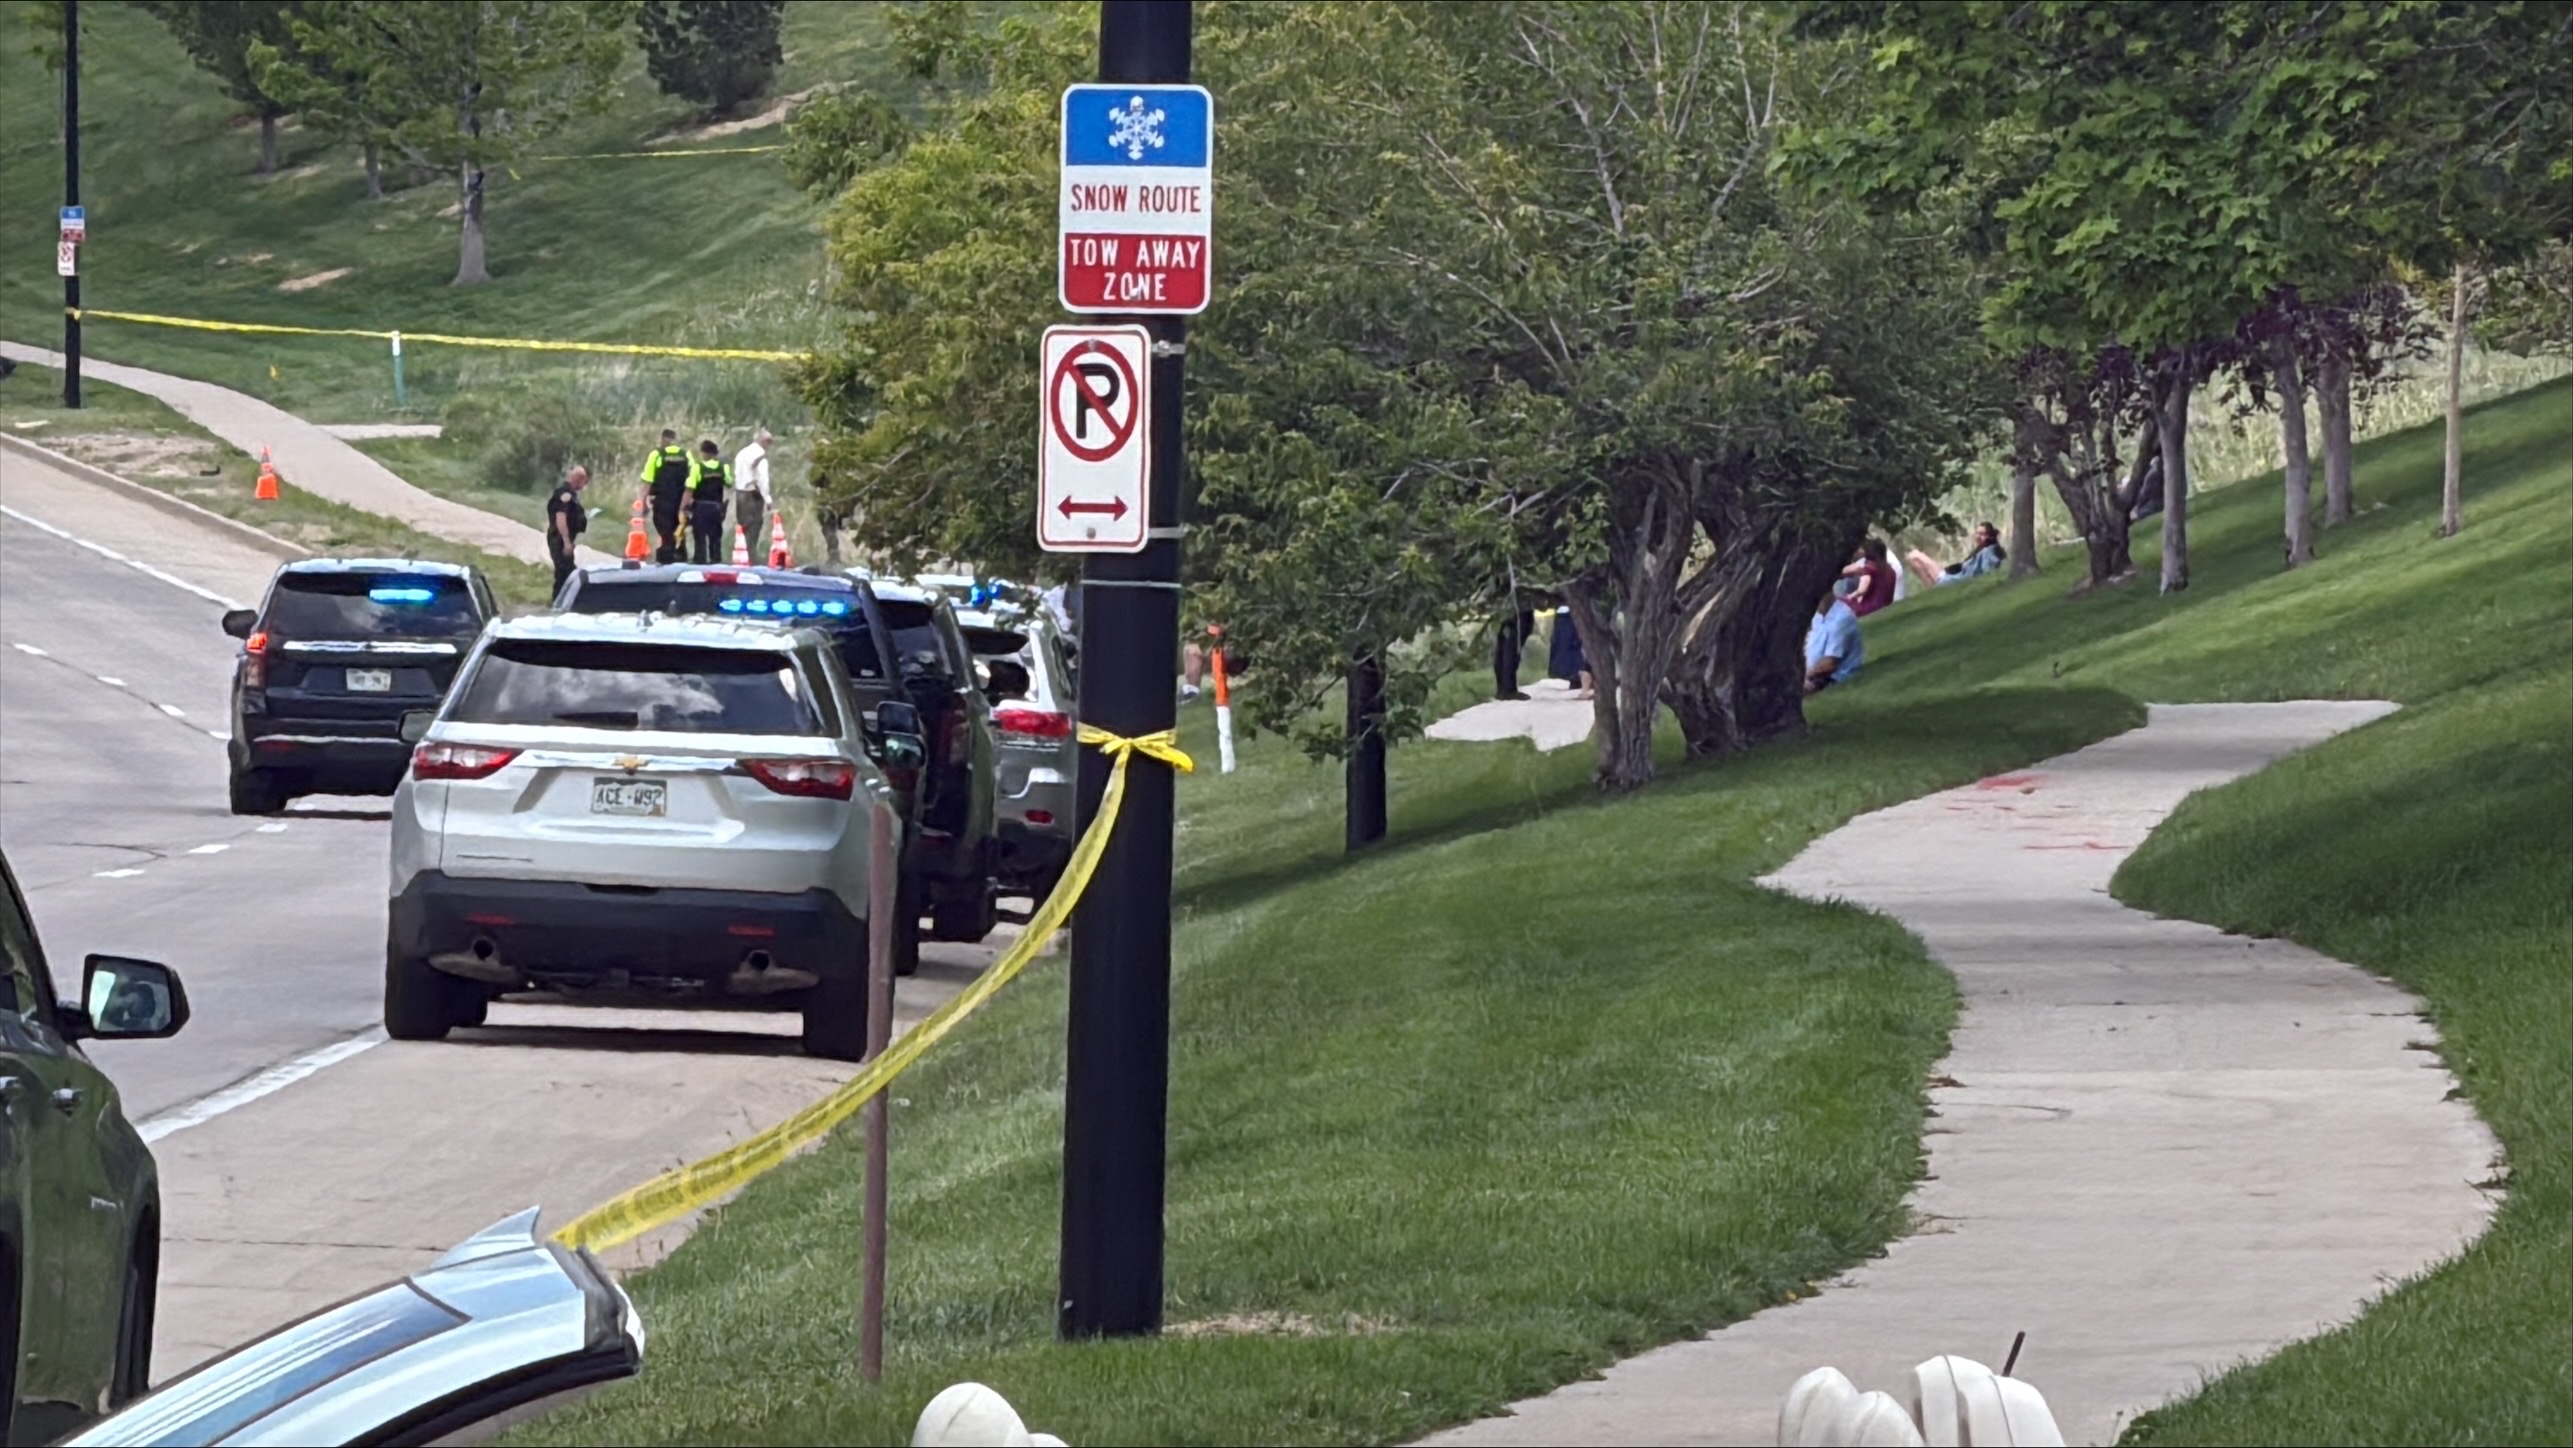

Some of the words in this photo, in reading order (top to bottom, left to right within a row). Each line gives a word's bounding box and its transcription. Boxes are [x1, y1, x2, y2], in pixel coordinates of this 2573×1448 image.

[1071, 184, 1128, 212] SNOW
[1139, 185, 1202, 213] ROUTE
[1070, 238, 1119, 266] TOW
[1136, 239, 1200, 269] AWAY
[1103, 271, 1167, 301] ZONE
